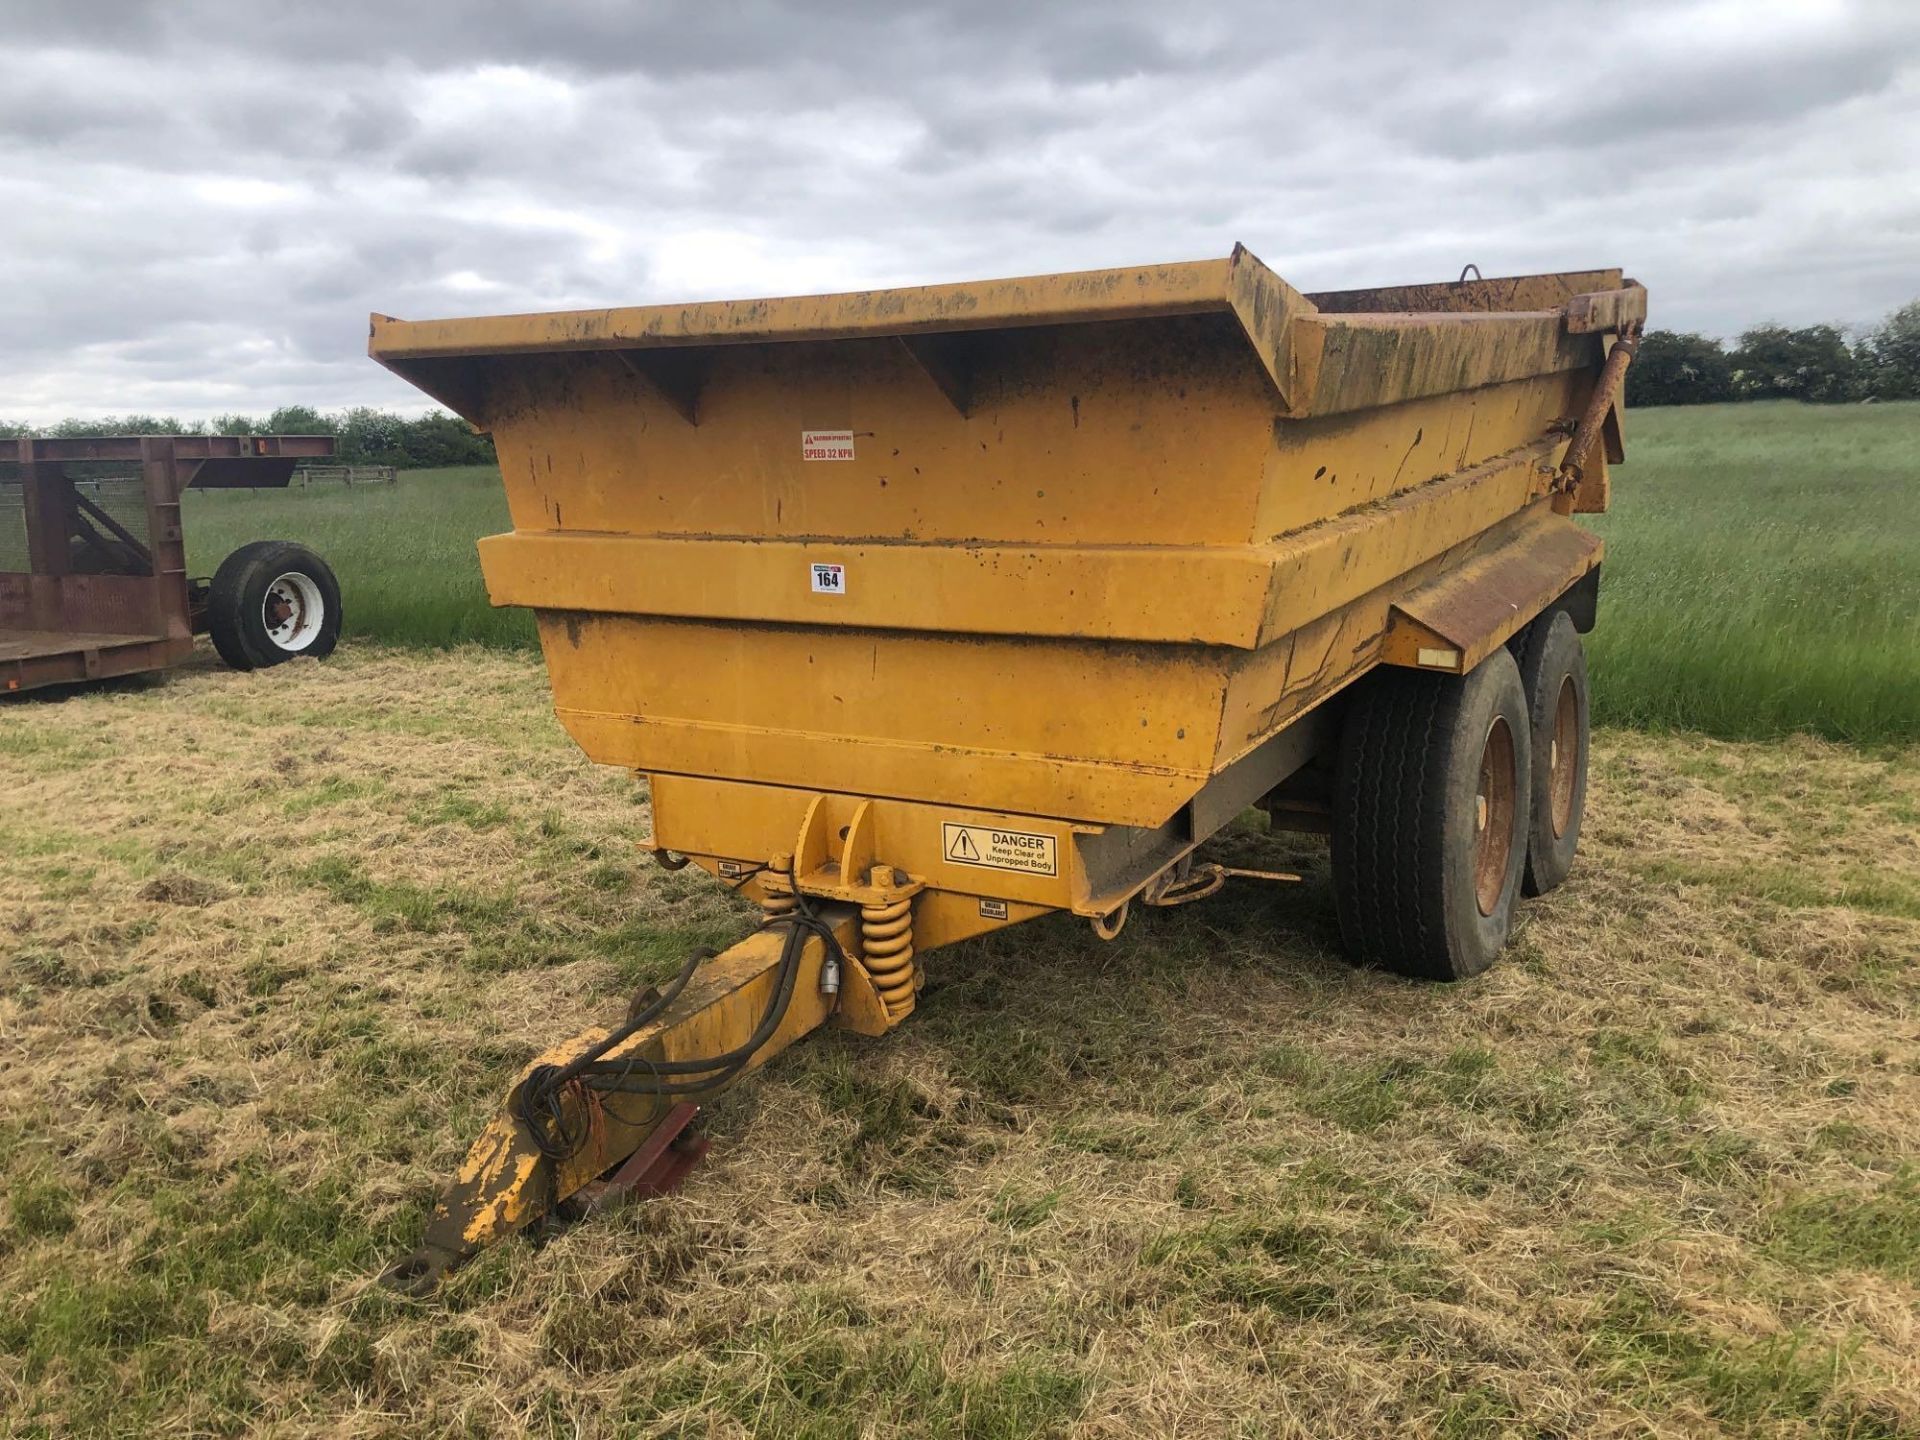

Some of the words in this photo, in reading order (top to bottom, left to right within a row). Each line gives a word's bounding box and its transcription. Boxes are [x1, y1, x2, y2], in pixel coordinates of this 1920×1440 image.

[805, 449, 826, 458] SPEED
[827, 449, 837, 458] 32
[838, 448, 853, 458] KPH
[817, 572, 838, 587] 164
[992, 833, 1045, 850] DANGER
[992, 846, 1012, 856] Keep
[1014, 848, 1034, 858] Clear
[986, 854, 1029, 867] Unpropped
[1031, 860, 1052, 871] Body
